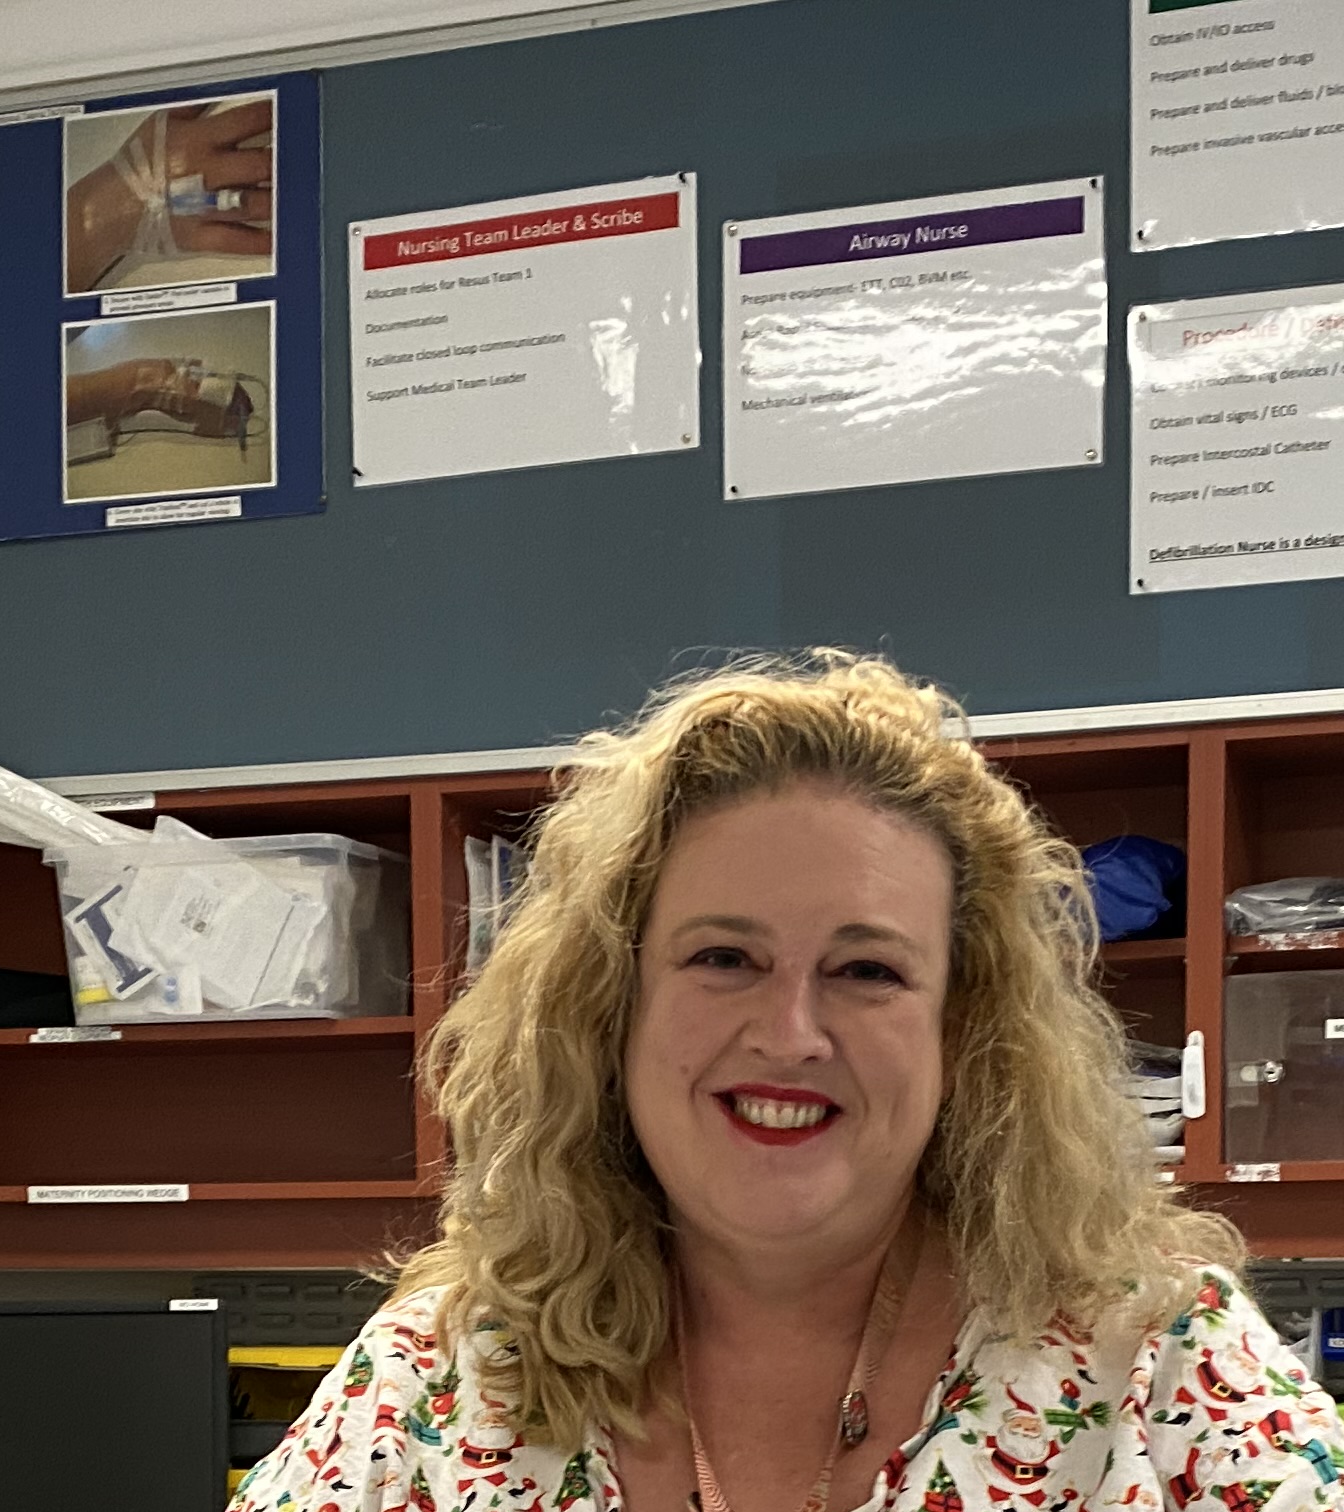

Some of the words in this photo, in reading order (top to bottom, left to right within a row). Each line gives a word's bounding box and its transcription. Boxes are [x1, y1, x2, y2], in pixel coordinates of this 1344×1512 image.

[398, 235, 460, 256] Nursing
[464, 229, 508, 247] Team
[513, 219, 569, 240] Leader
[573, 214, 586, 231] &
[590, 208, 643, 229] Scribe
[849, 230, 912, 251] Airway
[915, 223, 968, 244] Nurse
[366, 286, 407, 300] Allocate
[410, 282, 437, 294] roles
[439, 280, 456, 291] for
[493, 272, 523, 284] Team
[367, 386, 408, 402] Support
[412, 380, 455, 395] Medical
[456, 377, 487, 390] Team
[490, 370, 527, 386] Leader
[741, 393, 807, 410] Mechanical
[1149, 416, 1192, 430] Obtain
[1196, 410, 1224, 424] vital
[1226, 409, 1258, 424] signs
[1270, 404, 1297, 418] ECG
[1150, 451, 1199, 466] Prepare
[1203, 444, 1271, 462] Intercostal
[1274, 440, 1332, 456] Catheter
[1150, 488, 1198, 504] Prepare
[1212, 482, 1248, 496] insert
[1252, 481, 1274, 494] IDC
[1150, 541, 1234, 560] Defibrillation
[1238, 538, 1275, 552] Nurse
[1279, 537, 1291, 550] is
[37, 1190, 85, 1198] MATERNITY
[88, 1189, 143, 1198] POSITIONING
[147, 1188, 180, 1197] WEDGE
